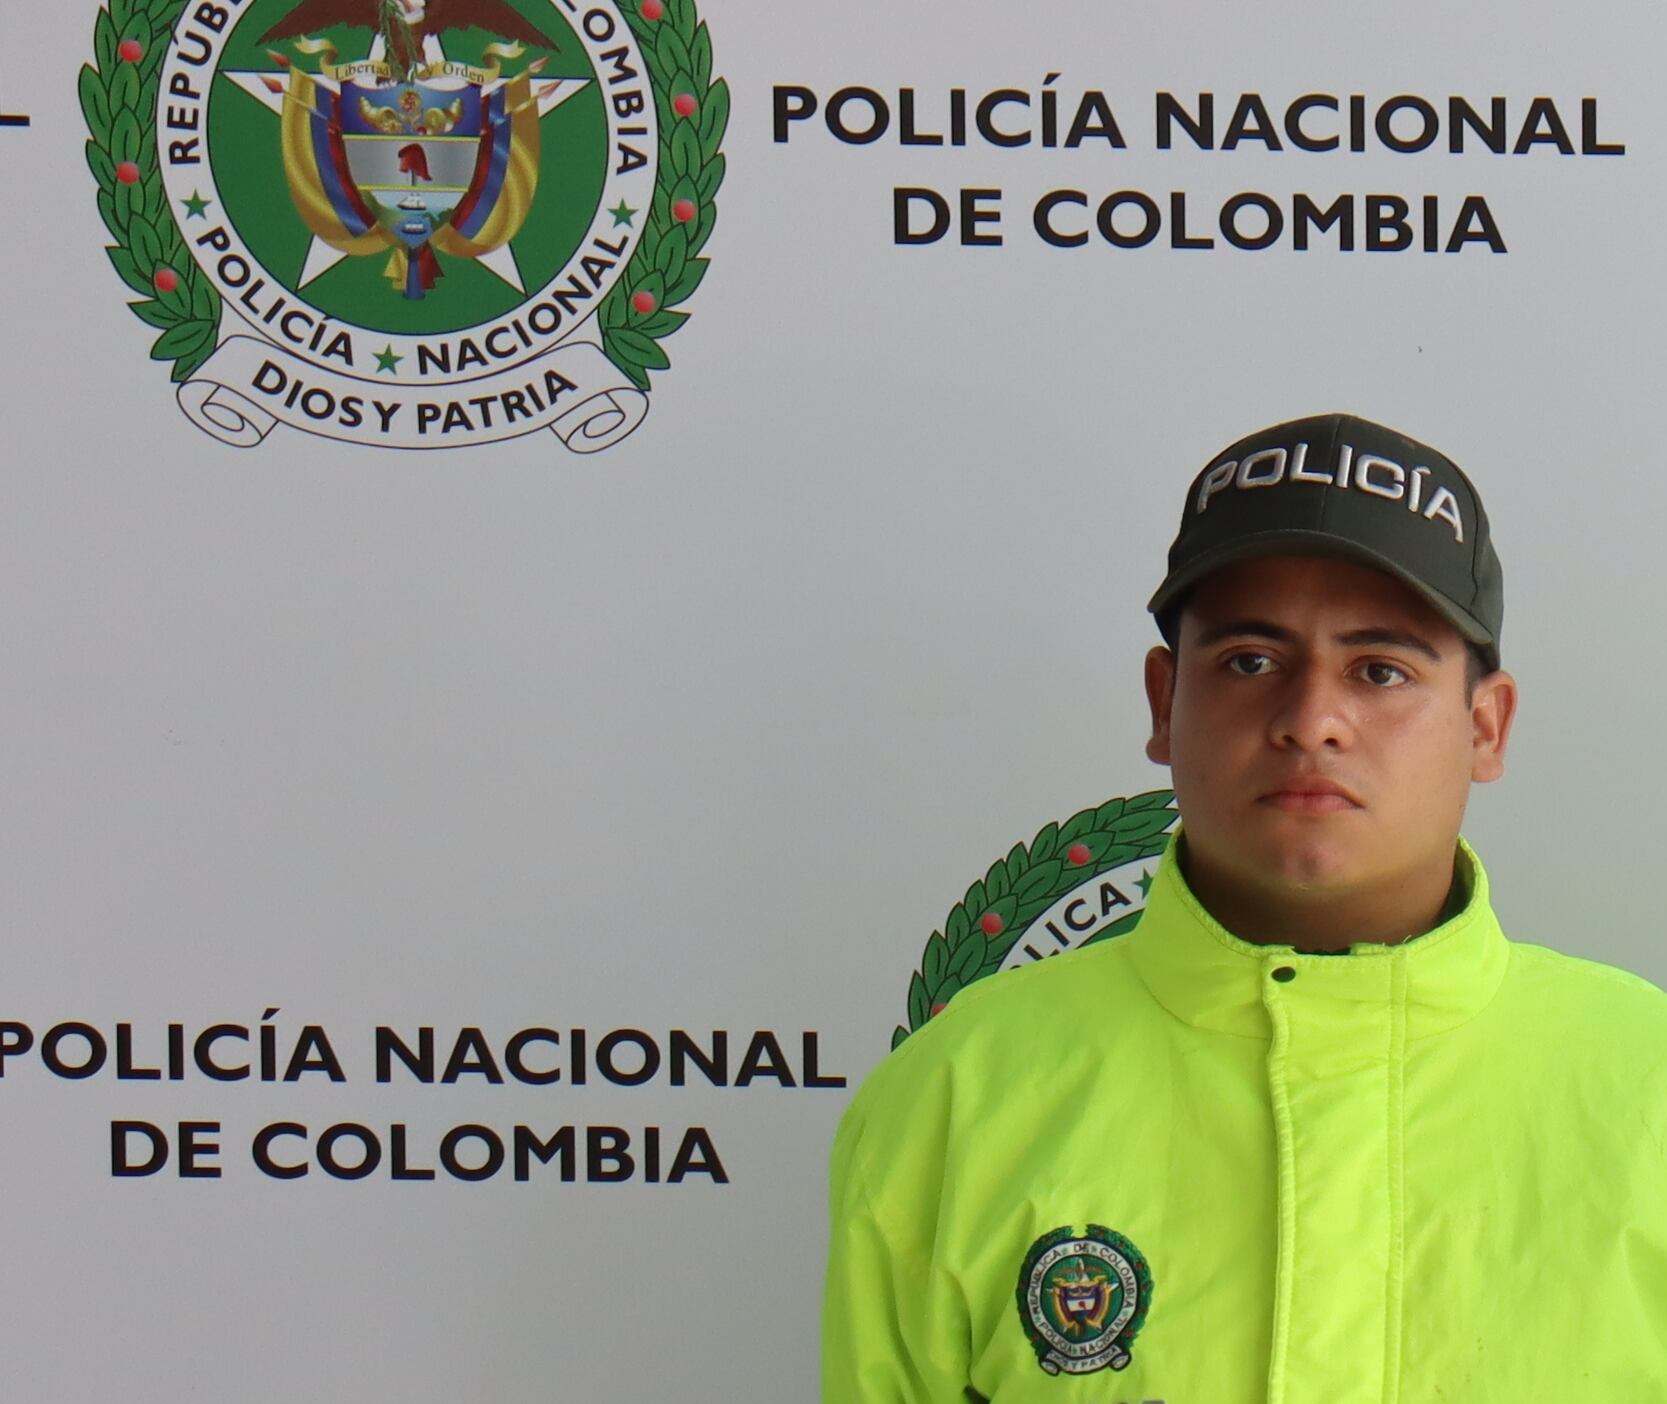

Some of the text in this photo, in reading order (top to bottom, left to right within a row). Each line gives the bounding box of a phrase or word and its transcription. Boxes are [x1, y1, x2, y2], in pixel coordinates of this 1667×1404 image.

[167, 0, 647, 175] REPÚB OMBIA
[443, 64, 485, 82] Orden
[773, 73, 1625, 155] POLICÍA NACIONAL
[894, 188, 1507, 253] DE COLOMBIA
[196, 226, 628, 376] POLICÍA NACIONAL
[417, 369, 579, 434] PATRIA
[1197, 443, 1463, 543] POLICÍA
[0, 1008, 846, 1088] POLICÍA NACIONAL
[111, 1121, 729, 1183] DE COLOMBIA
